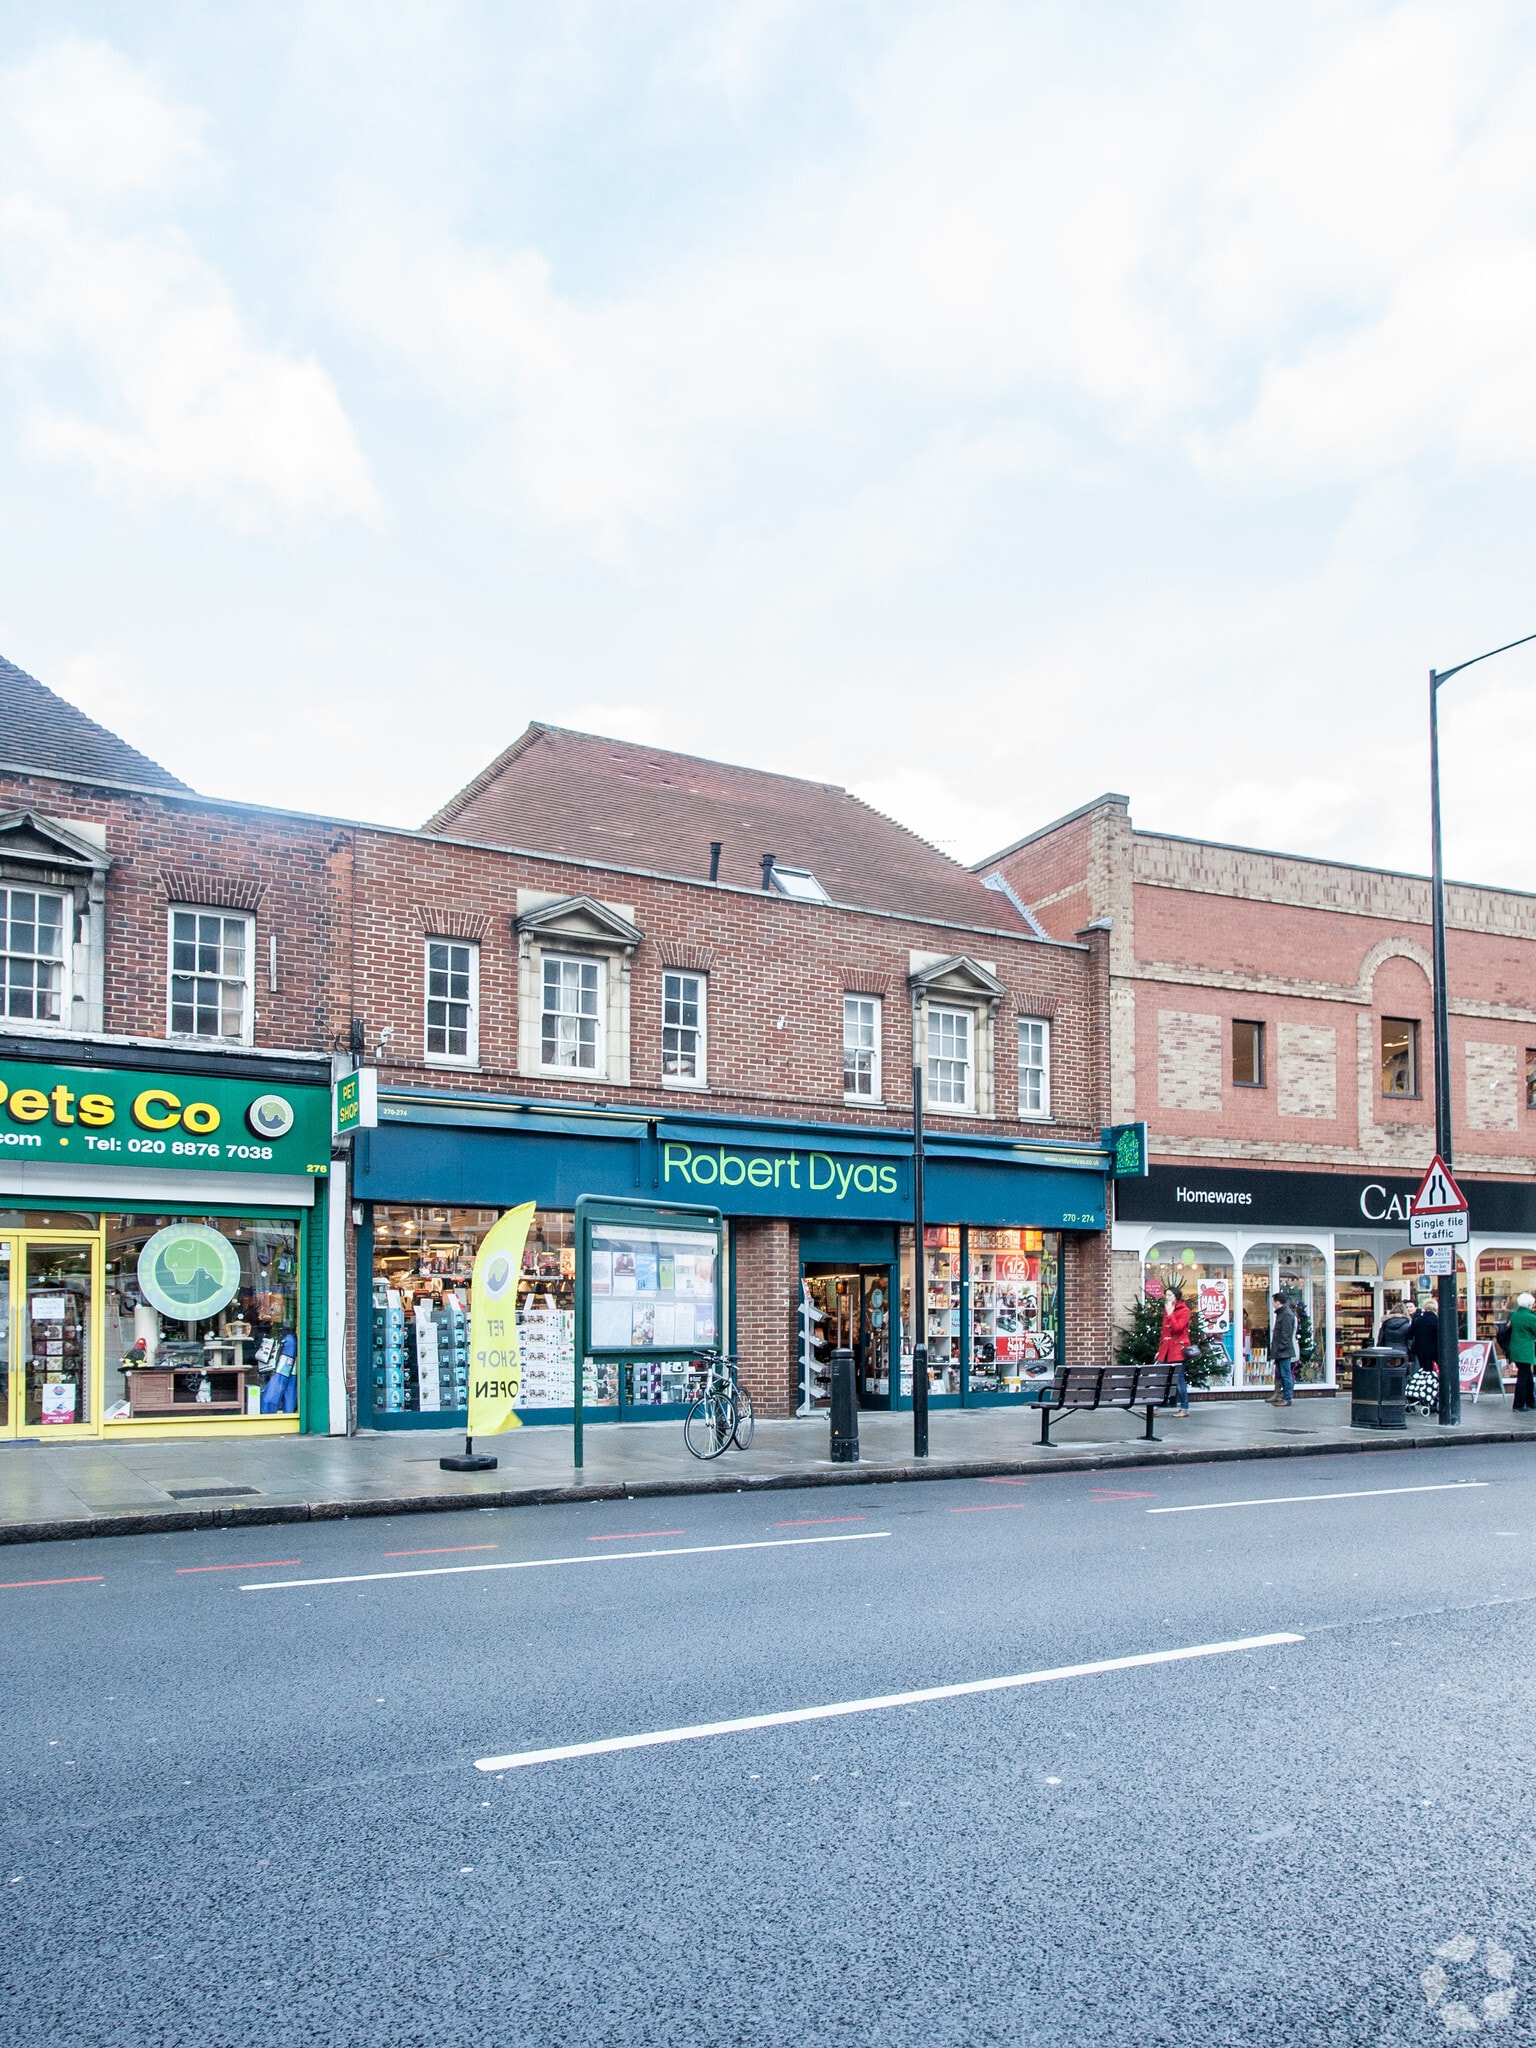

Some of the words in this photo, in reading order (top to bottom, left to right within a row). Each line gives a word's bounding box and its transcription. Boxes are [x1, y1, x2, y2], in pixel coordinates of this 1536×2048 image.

[342, 1081, 356, 1101] PET
[0, 1079, 115, 1127] ets
[132, 1089, 221, 1133] Co
[339, 1101, 359, 1123] SHOP
[84, 1136, 122, 1151] Tel:
[127, 1139, 166, 1154] 020
[171, 1141, 220, 1157] 8876
[225, 1144, 273, 1160] 7038
[306, 1164, 328, 1173] 276
[664, 1142, 801, 1189] Robert
[809, 1152, 898, 1200] Dyas
[1176, 1187, 1252, 1205] Homewares
[1062, 1213, 1076, 1223] 270
[1081, 1214, 1095, 1223] 274
[1414, 1218, 1444, 1230] Single
[1448, 1216, 1463, 1226] file
[1423, 1229, 1454, 1239] traffic
[1201, 1295, 1224, 1304] HALF
[1201, 1303, 1225, 1312] PRICE
[1459, 1365, 1479, 1373] RICE
